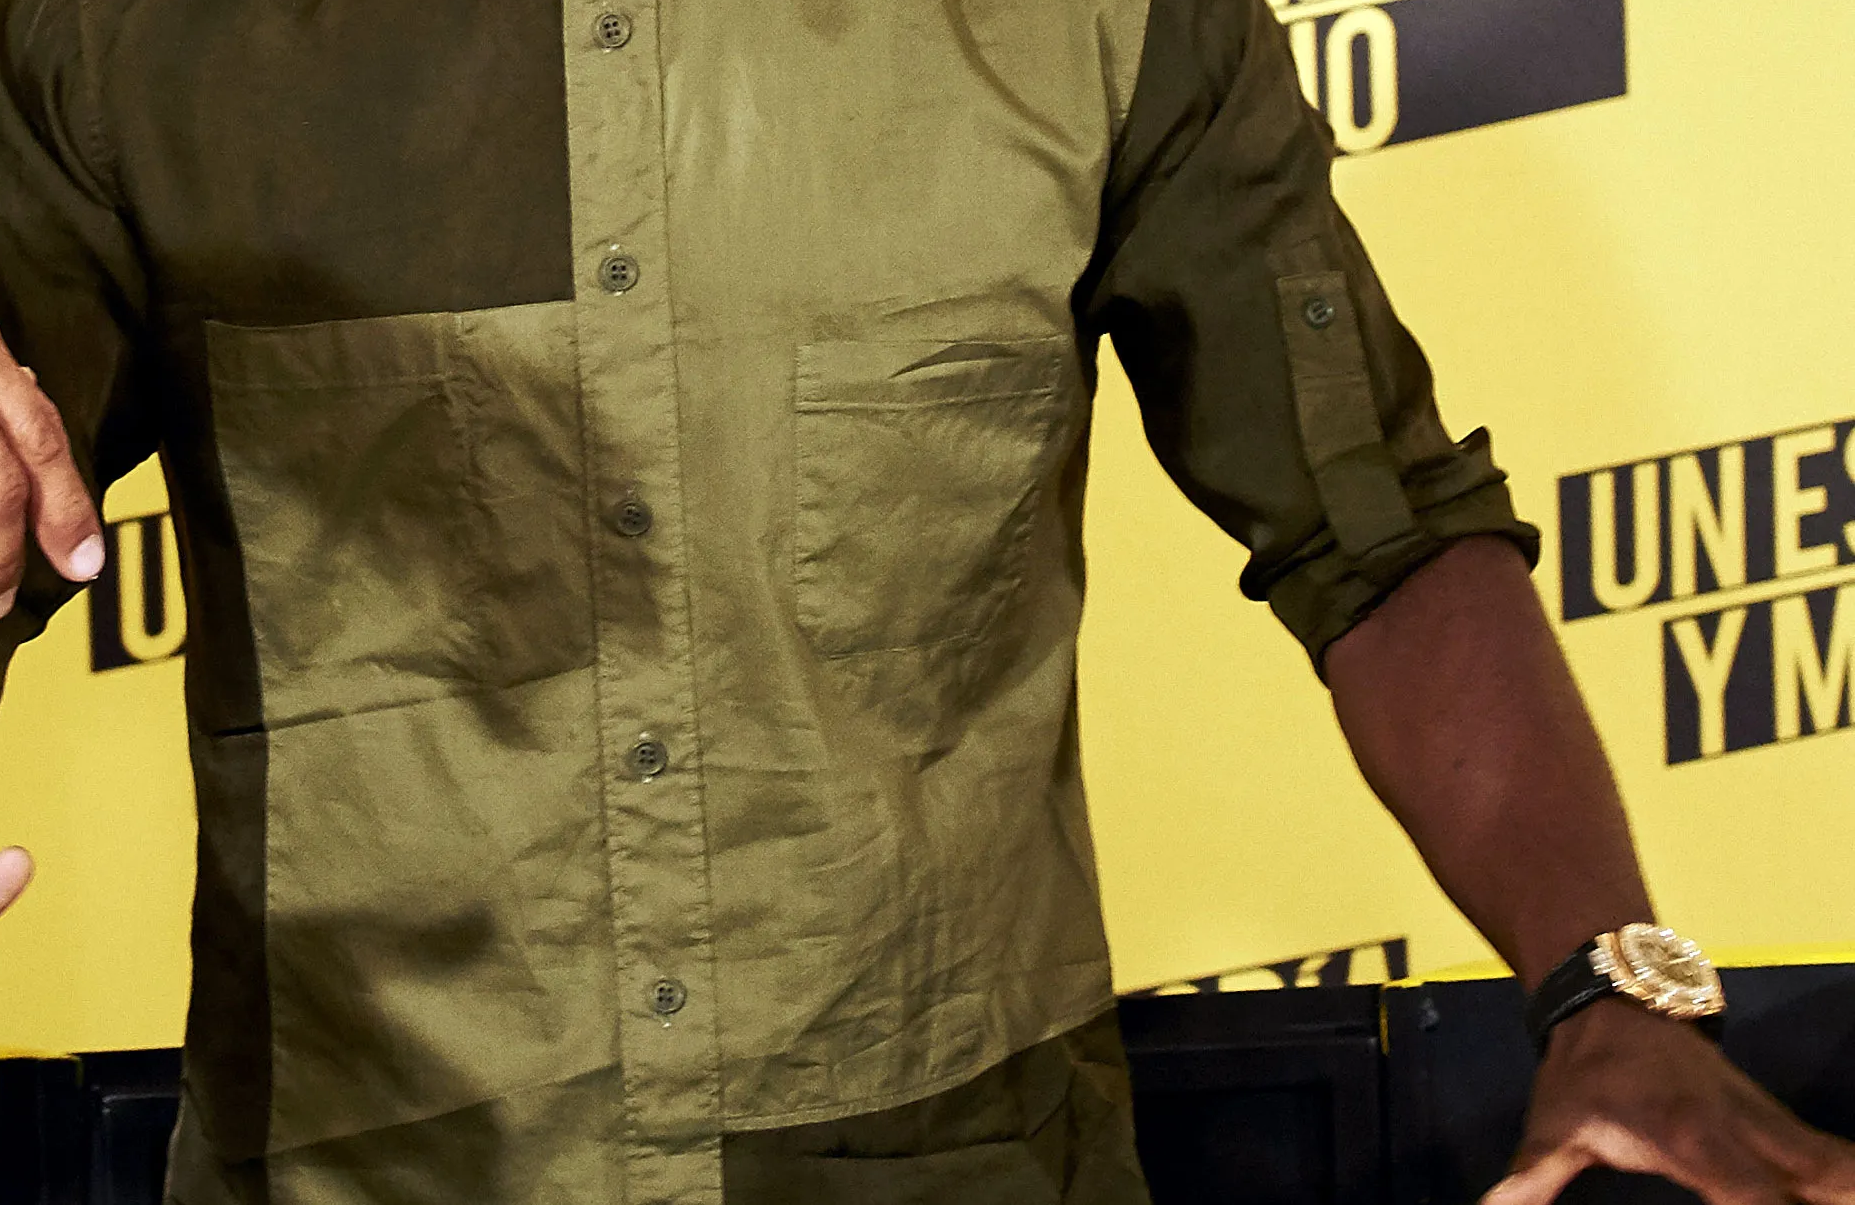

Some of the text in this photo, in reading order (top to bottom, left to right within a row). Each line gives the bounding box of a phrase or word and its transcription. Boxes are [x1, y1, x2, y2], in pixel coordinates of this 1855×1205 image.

[1589, 420, 1855, 611] UN E
[1671, 607, 1747, 759] Y
